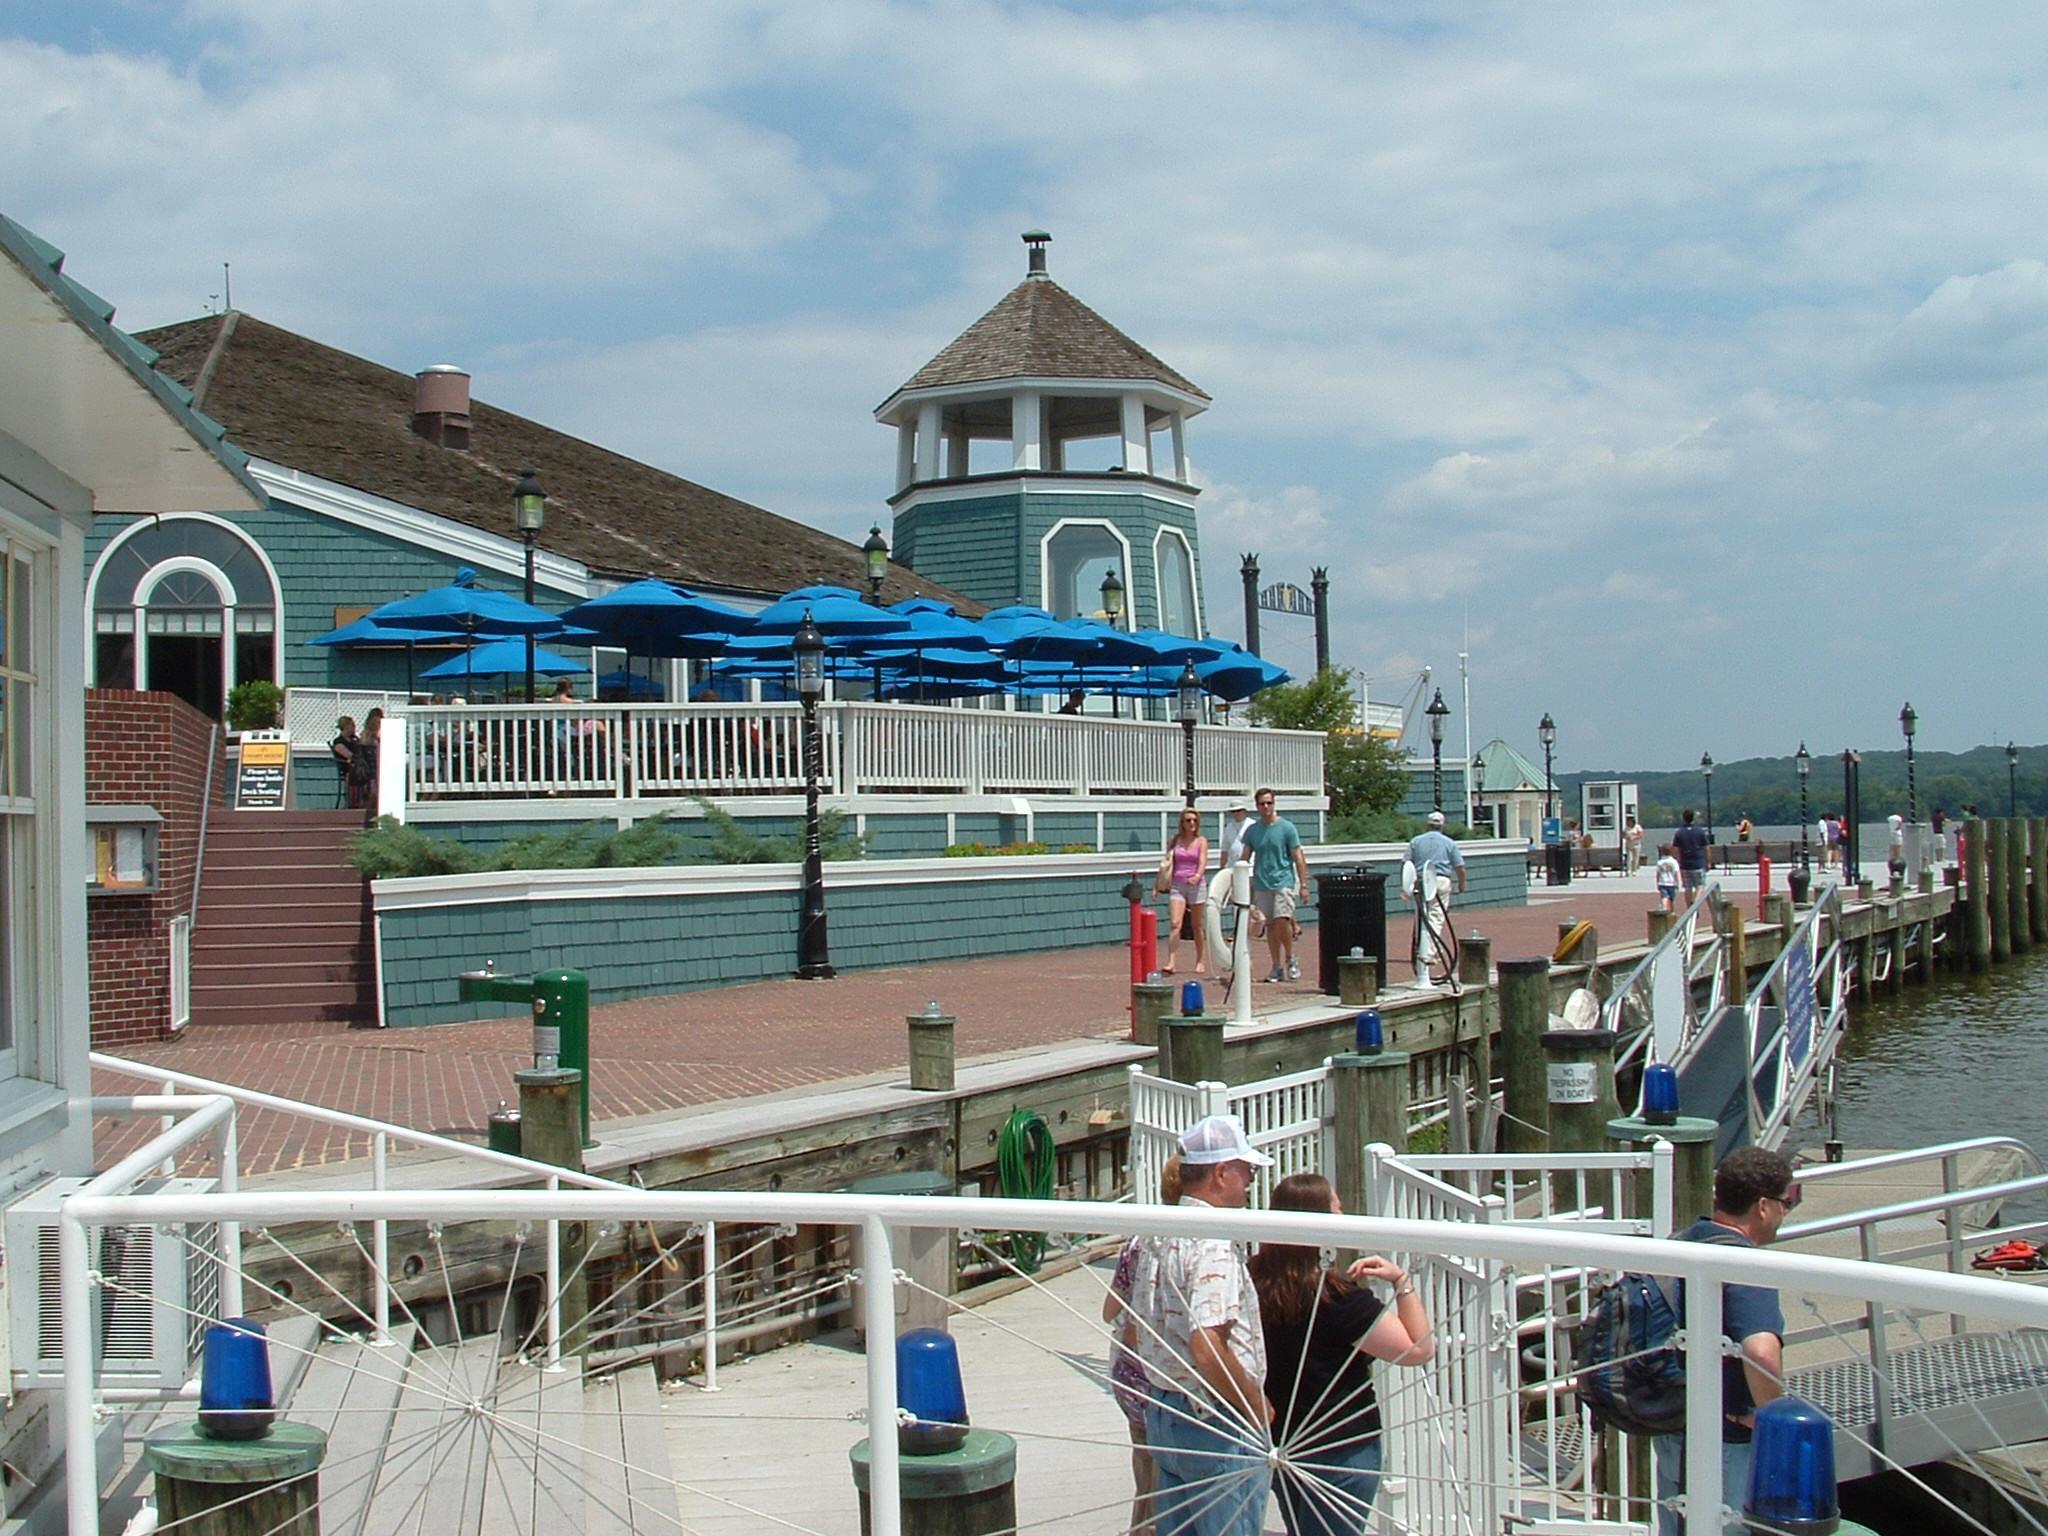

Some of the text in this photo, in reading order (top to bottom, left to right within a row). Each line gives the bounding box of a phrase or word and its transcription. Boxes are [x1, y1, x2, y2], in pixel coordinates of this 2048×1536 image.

[258, 788, 281, 796] Seating
[1562, 1068, 1574, 1077] NO
[1555, 1089, 1585, 1098] ON BOAT
